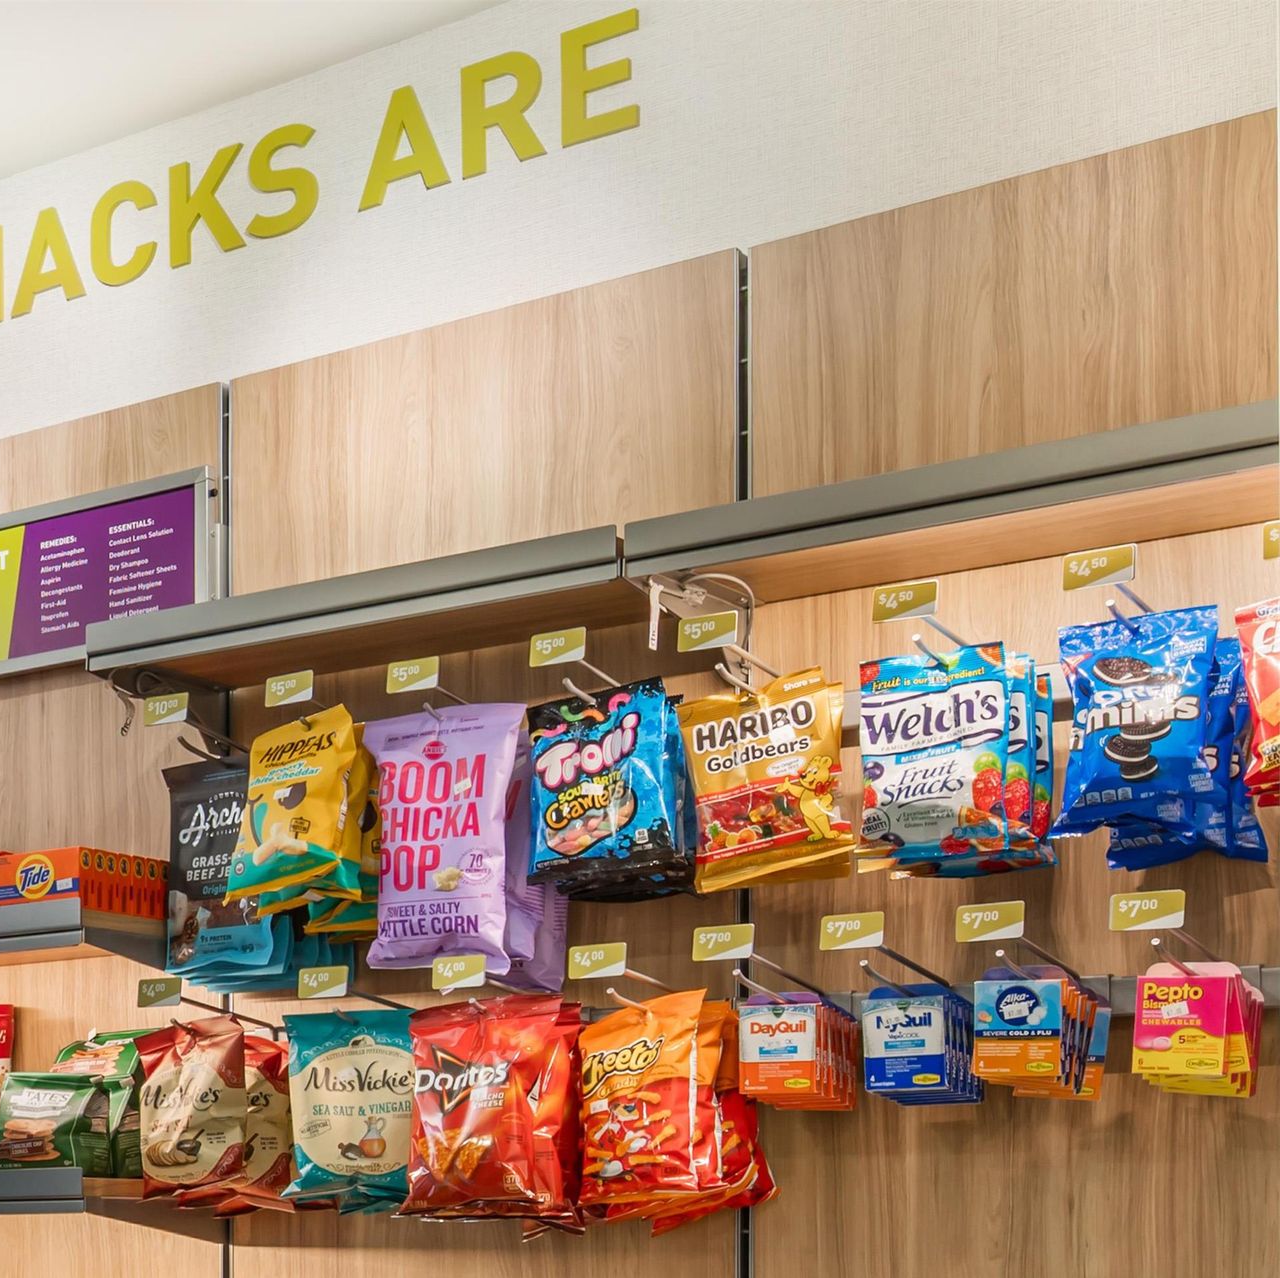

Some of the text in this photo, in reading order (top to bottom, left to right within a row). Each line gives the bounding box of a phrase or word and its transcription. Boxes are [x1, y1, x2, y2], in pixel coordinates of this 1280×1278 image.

[357, 8, 640, 214] ARE
[109, 518, 154, 534] ESSENTIALS:
[40, 536, 77, 550] REMEDIES:
[109, 528, 173, 546] Contact Lens Solution
[40, 547, 85, 561] Acetaminophen
[109, 547, 140, 559] Deodorant
[40, 559, 88, 574] Allergy Medicine
[109, 558, 148, 572] Dry Shampoo
[109, 564, 177, 584] Fabric Softener Sheets
[40, 576, 61, 585] Aspirin
[109, 580, 162, 596] Feminine Hygiene
[41, 584, 82, 598] Decongestants
[109, 594, 152, 608] Hand Sanitizer
[41, 599, 66, 609] First-Aid
[41, 611, 69, 621] Ibuprofen
[41, 623, 66, 634] Stomach
[862, 690, 1000, 745] Welch's
[258, 731, 337, 764] HIPPEAS
[537, 712, 641, 787] Trolli
[707, 736, 810, 773] Goldbears
[380, 754, 486, 804] BOOM
[899, 760, 959, 785] Fruit
[882, 774, 964, 803] Snacks
[379, 803, 480, 843] CHICKA
[19, 864, 51, 888] Tide
[379, 846, 440, 894] POP
[388, 901, 460, 918] SWEET & SALTY
[432, 914, 479, 934] CORN
[1143, 983, 1202, 1006] Pepto
[750, 1020, 807, 1040] DayQuil
[415, 1061, 509, 1092] Doritos
